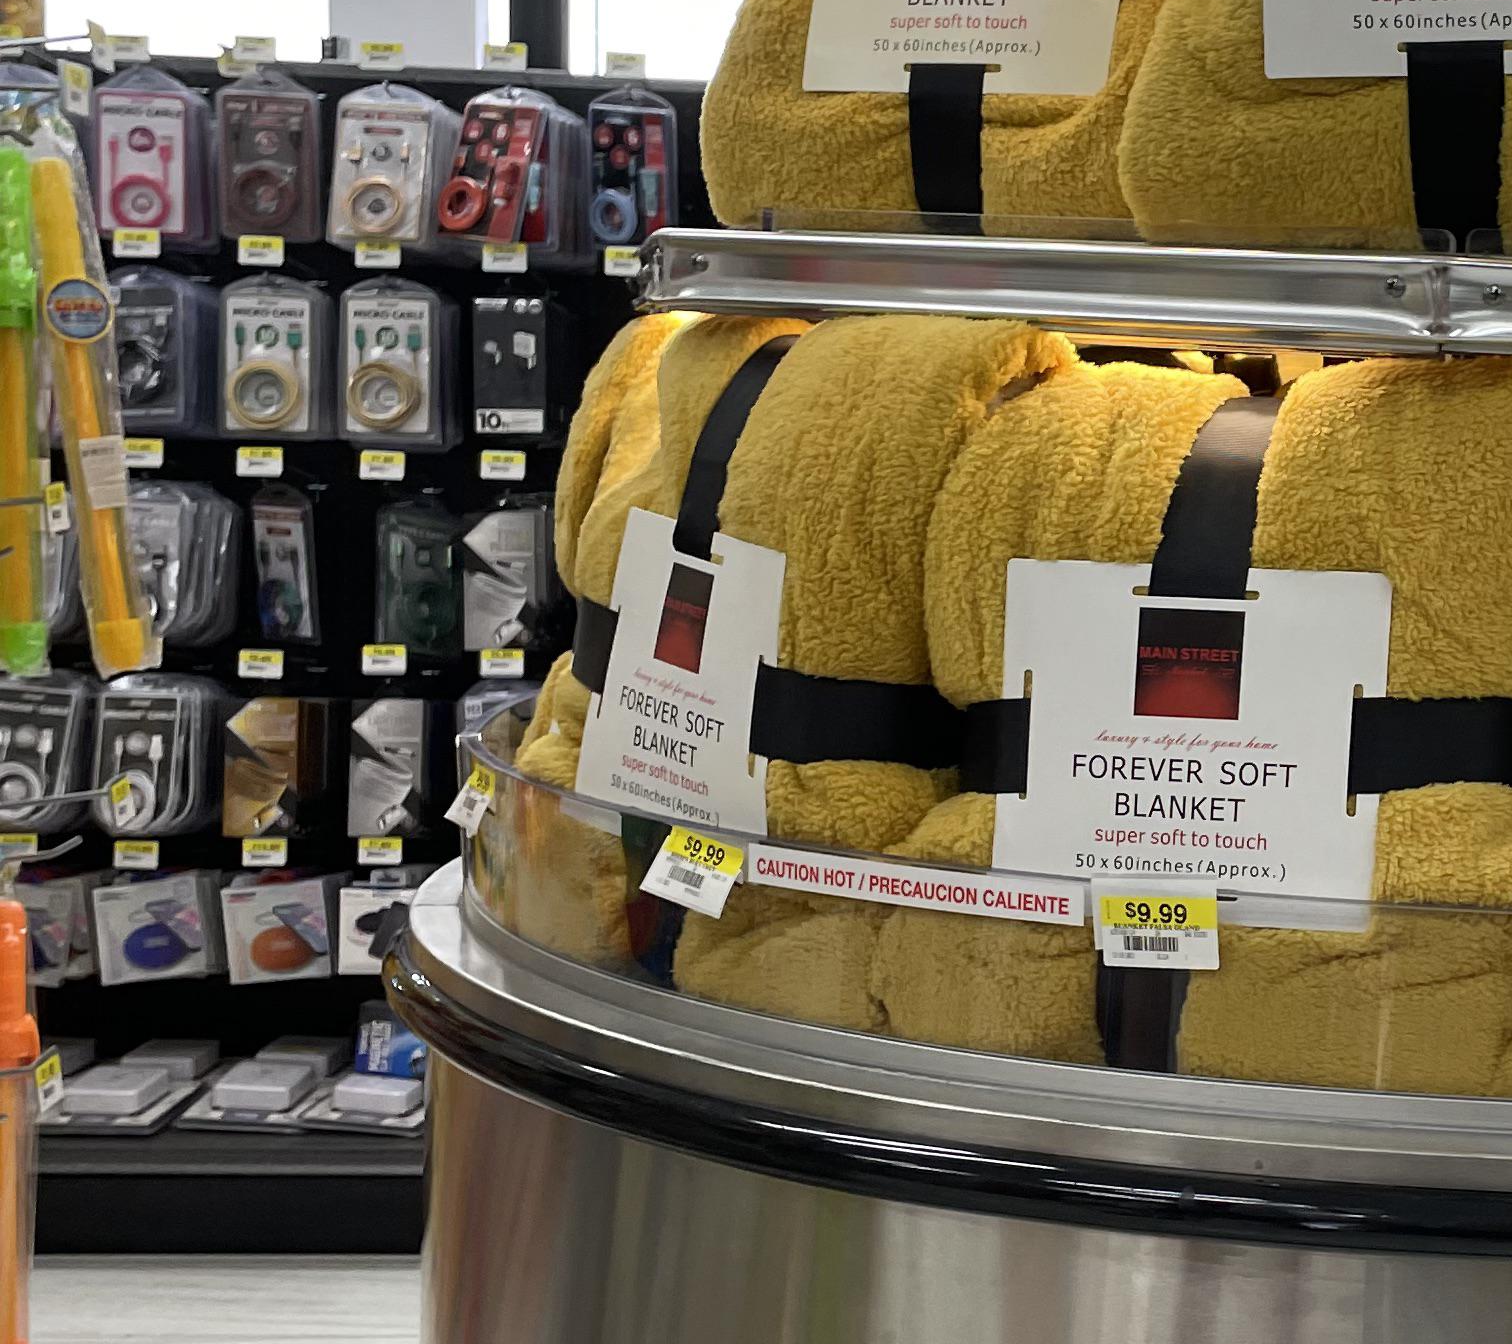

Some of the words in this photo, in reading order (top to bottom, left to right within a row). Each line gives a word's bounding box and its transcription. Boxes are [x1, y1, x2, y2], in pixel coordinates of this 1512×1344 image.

[890, 16, 930, 32] super
[934, 14, 963, 30] soft
[966, 16, 982, 29] to
[985, 15, 1027, 29] touch
[1353, 15, 1373, 29] 50
[1380, 18, 1388, 29] x
[873, 39, 888, 53] 50
[1140, 646, 1178, 660] MAIN
[1180, 647, 1239, 662] STREET
[620, 685, 678, 728] FOREVER
[686, 710, 725, 743] SOFT
[633, 726, 697, 767] BLANKET
[622, 755, 645, 777] super
[648, 763, 668, 781] soft
[670, 770, 680, 785] to
[681, 773, 709, 796] touch
[1072, 754, 1203, 784] FOREVER
[1220, 762, 1297, 788] SOFT
[1115, 792, 1246, 822] BLANKET
[684, 836, 725, 866] $9.99
[1095, 828, 1144, 846] super
[1151, 830, 1186, 846] soft
[1191, 832, 1209, 847] to
[1215, 833, 1267, 851] touch
[1076, 854, 1094, 868] 50
[1100, 858, 1108, 869] x
[756, 857, 820, 884] CAUTION
[823, 869, 855, 887] HOT
[858, 871, 865, 890] /
[869, 873, 978, 906] PRECAUCION
[983, 889, 1070, 915] CALIENTE
[1125, 902, 1187, 924] $9.99
